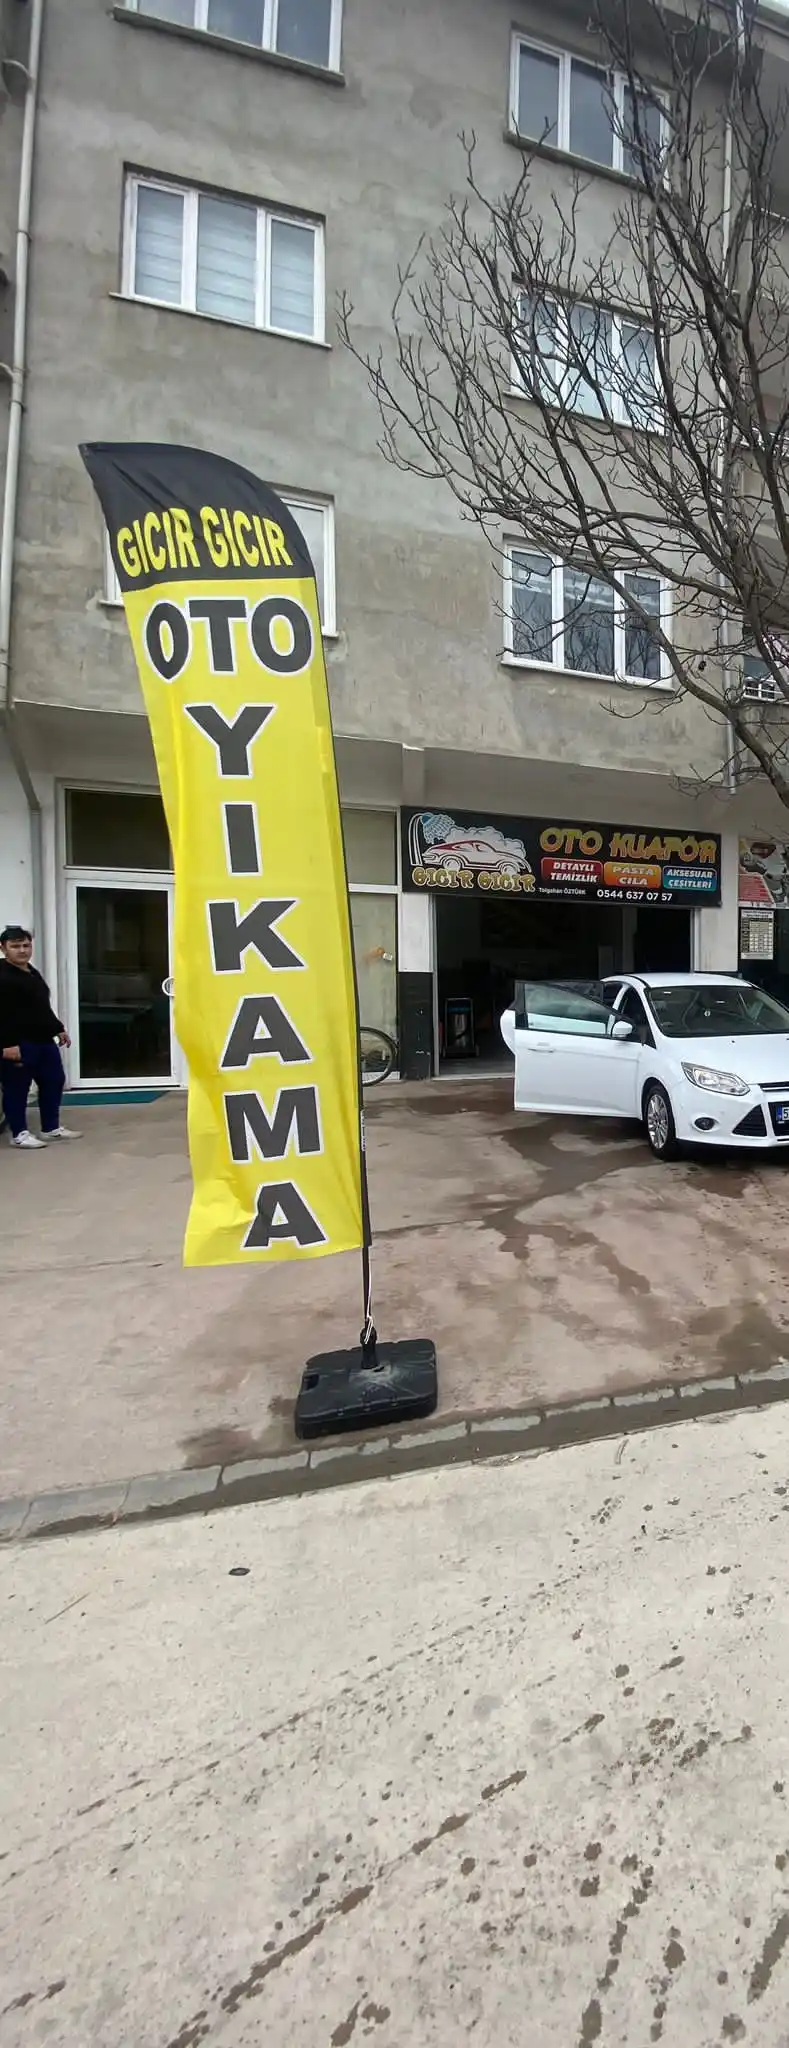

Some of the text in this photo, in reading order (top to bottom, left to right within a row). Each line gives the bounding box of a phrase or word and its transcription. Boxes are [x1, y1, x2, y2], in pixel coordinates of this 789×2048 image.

[117, 506, 293, 577] GICIR GICIR
[144, 596, 313, 682] OTO
[539, 827, 603, 856] OTO
[553, 862, 594, 872] DETAYLI
[666, 869, 713, 879] AKSESUAR
[596, 889, 673, 901] 0544 637 07 57
[184, 703, 328, 1250] YIKAMA
